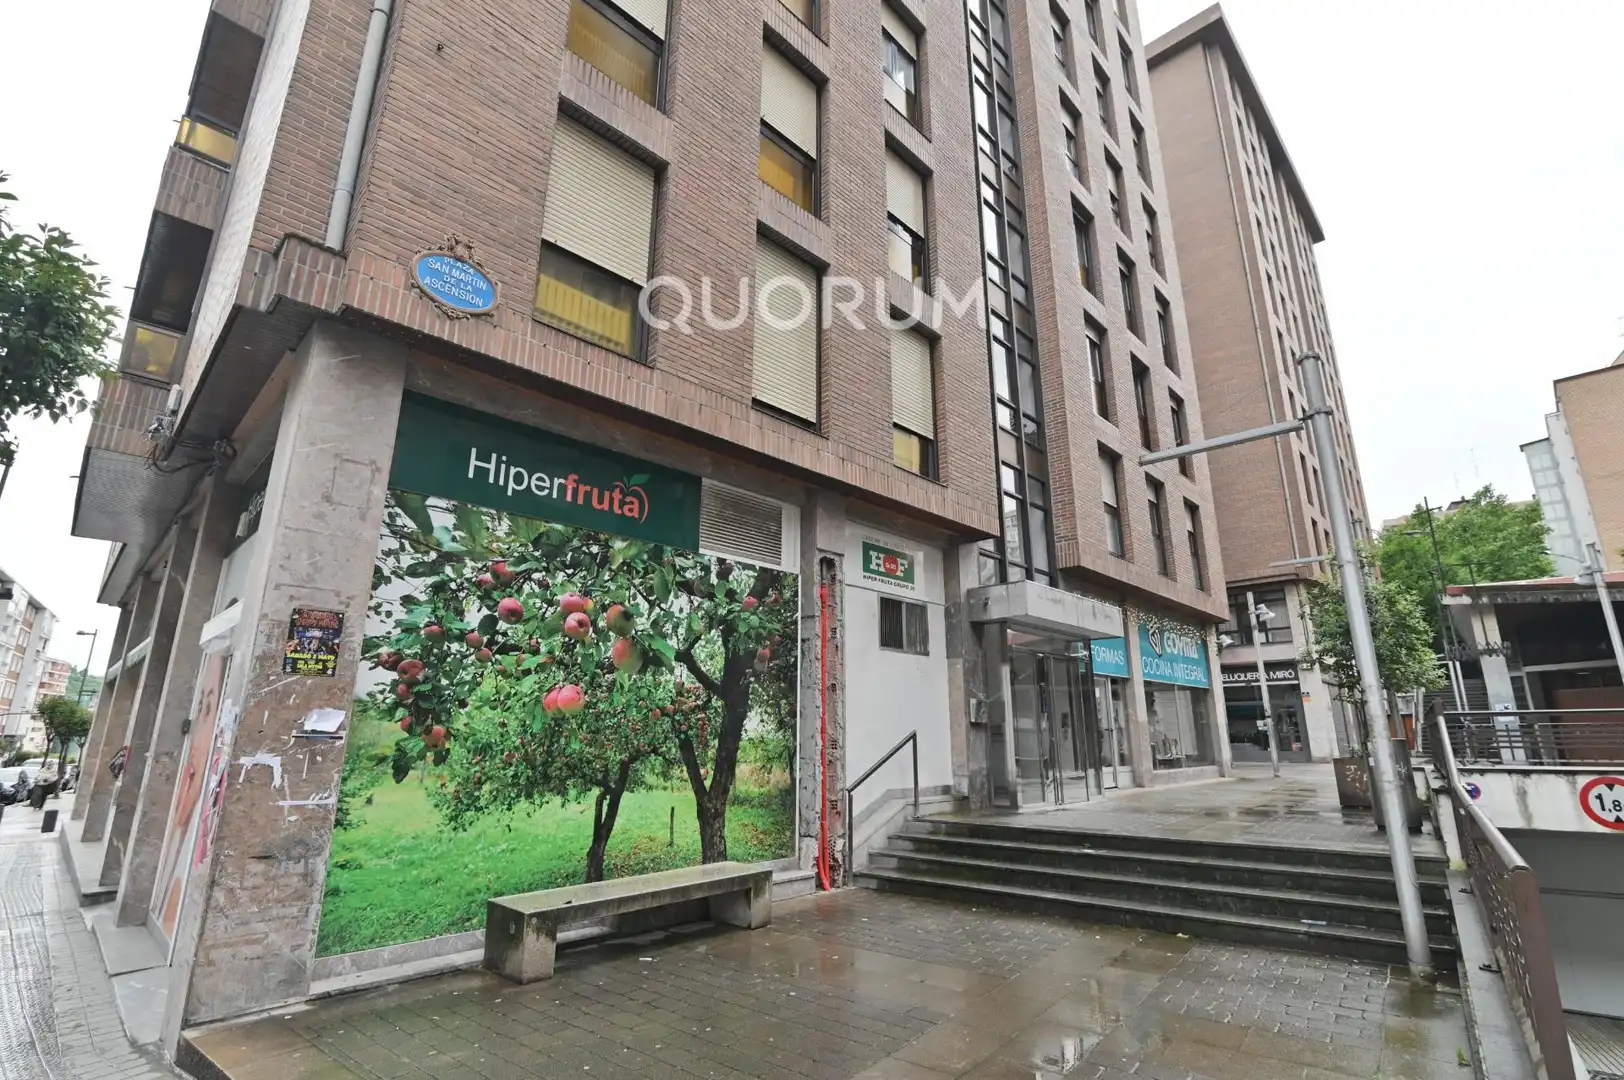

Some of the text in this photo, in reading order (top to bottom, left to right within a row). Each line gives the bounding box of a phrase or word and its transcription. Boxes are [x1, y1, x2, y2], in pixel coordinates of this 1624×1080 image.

[427, 258, 487, 290] SAN MARTIN
[444, 256, 474, 275] PLAZA
[423, 276, 483, 307] ASCENSION
[443, 275, 473, 292] DE LA
[1142, 656, 1207, 682] COCINA INTEGRAL
[1269, 669, 1295, 679] MIRÓ
